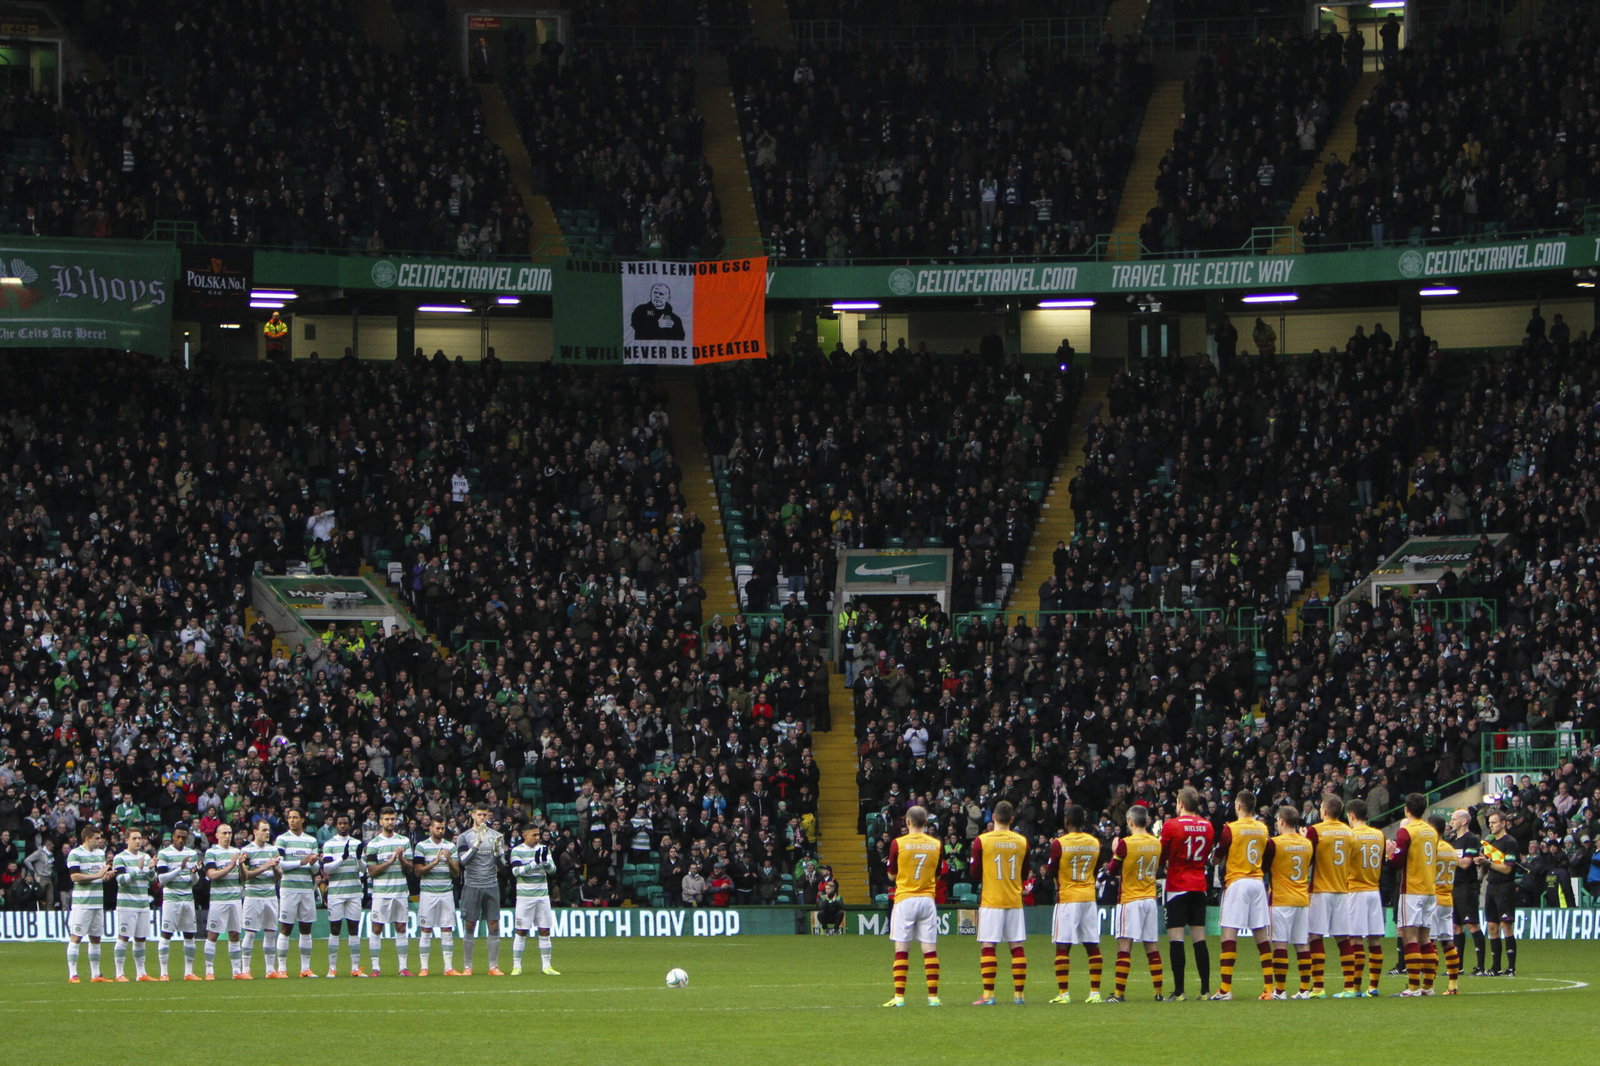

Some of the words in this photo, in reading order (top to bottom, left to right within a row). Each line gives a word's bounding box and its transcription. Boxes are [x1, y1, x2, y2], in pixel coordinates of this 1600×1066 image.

[565, 259, 623, 274] AIRDRIE
[628, 262, 658, 275] NEIL
[661, 263, 718, 276] LENNON
[721, 260, 751, 273] CSC
[1425, 242, 1567, 276] CELTICFCTRAVEL.COM
[187, 270, 226, 289] POLSKA
[227, 277, 246, 290] No.1
[398, 263, 552, 291] CELTICFCTRAVEL.COM
[916, 266, 1078, 294] CELTICFCTRAVEL.COM
[1111, 264, 1167, 288] TRAVEL
[1172, 262, 1200, 286] THE
[1203, 260, 1253, 285] CELTIC
[1257, 259, 1295, 283] WAY
[560, 345, 581, 359] WE
[624, 345, 668, 359] NEVER
[671, 346, 687, 359] BE
[692, 340, 760, 359] DEFEATED
[1183, 835, 1206, 862] 12
[1246, 839, 1258, 865] 6
[1333, 840, 1345, 866] 5
[1359, 843, 1381, 869] 18
[1424, 841, 1434, 867] 9
[912, 853, 928, 880] 7
[992, 854, 1017, 880] 11
[1069, 855, 1093, 881] 17
[1135, 855, 1158, 881] 14
[1289, 855, 1302, 881] 3
[1435, 860, 1457, 885] 25
[550, 910, 631, 937] MATCH
[639, 910, 686, 937] DAY
[694, 910, 740, 937] APP
[1529, 909, 1569, 940] NEW
